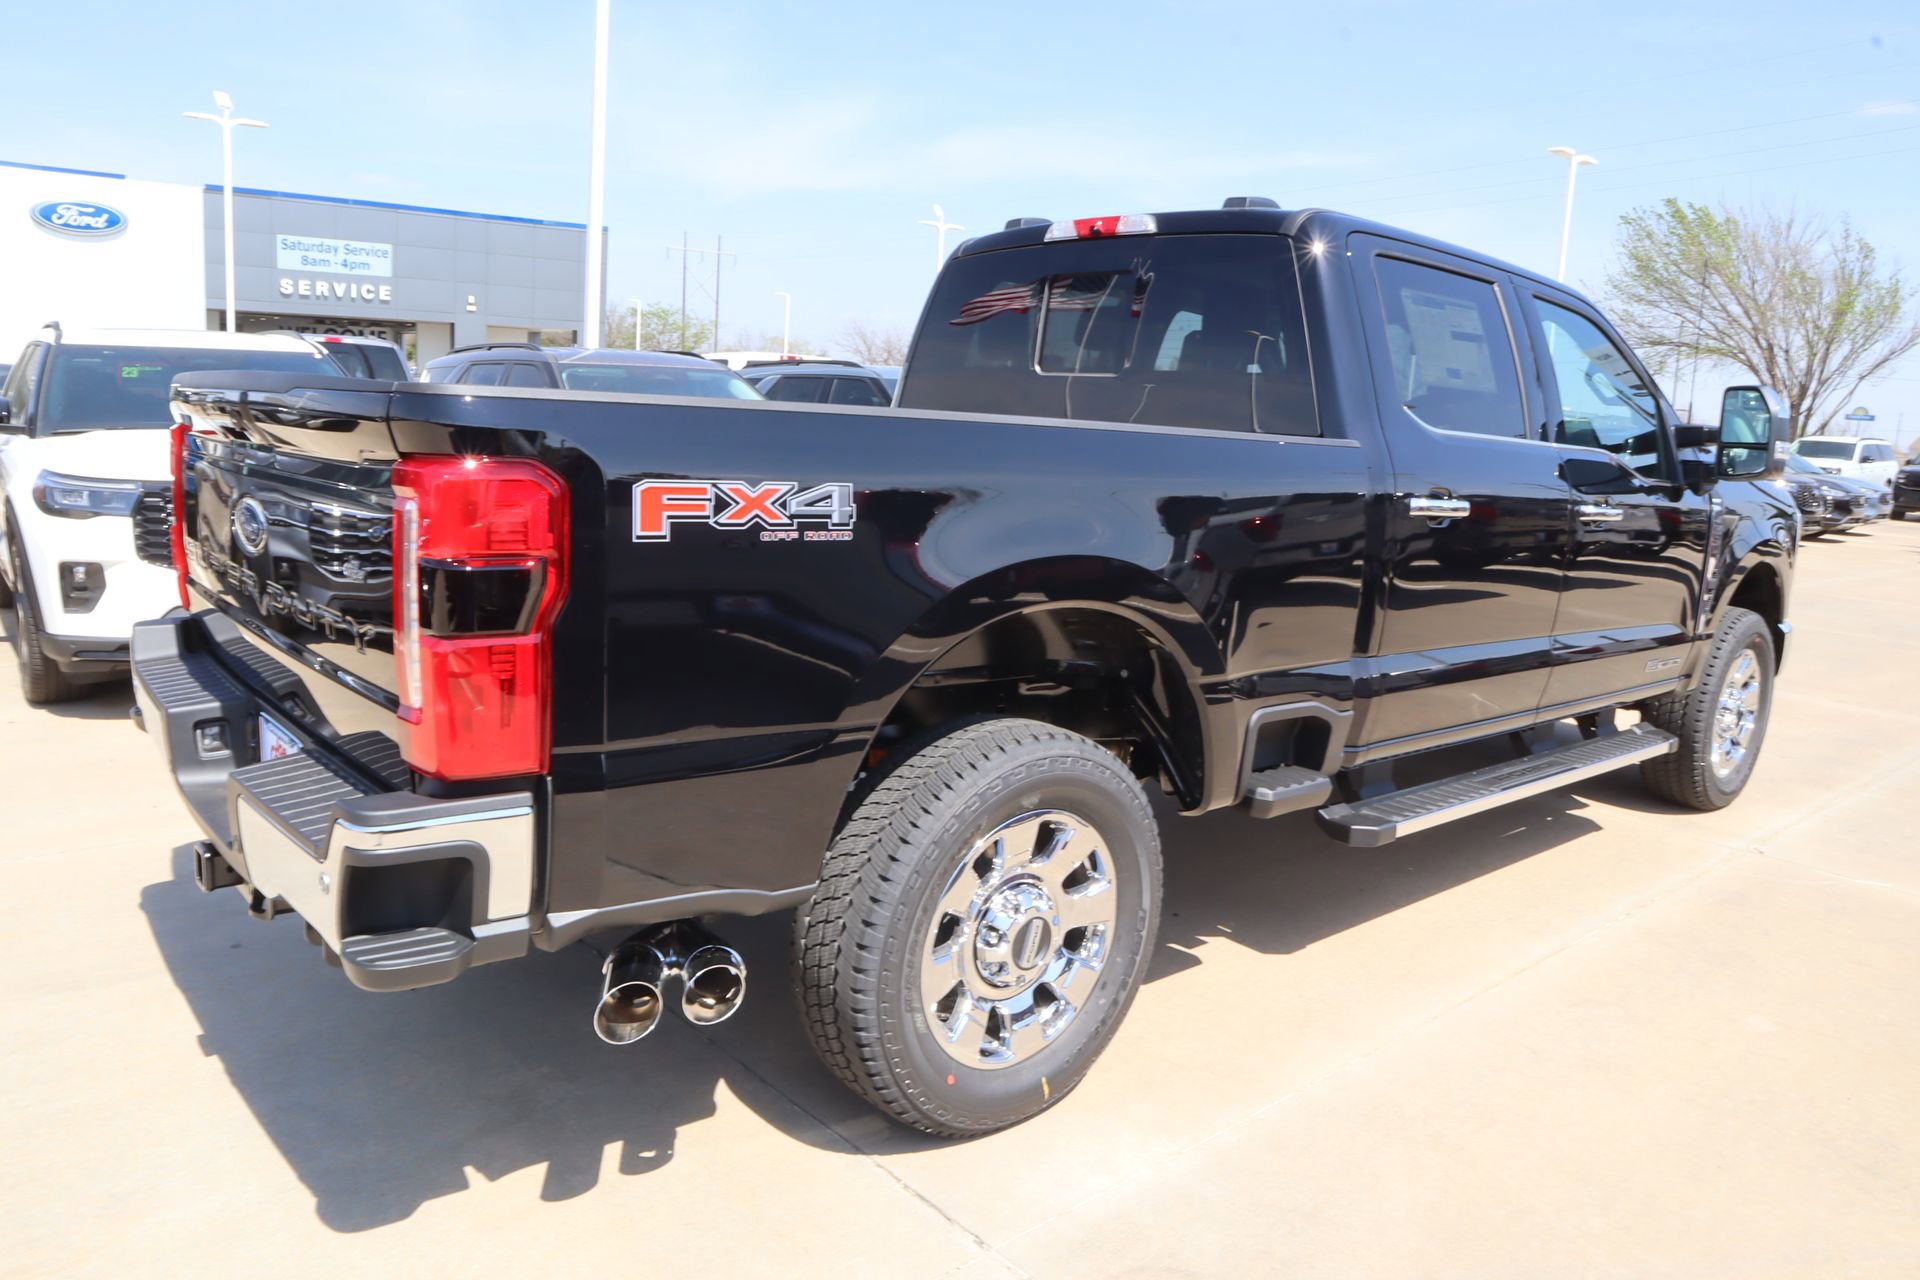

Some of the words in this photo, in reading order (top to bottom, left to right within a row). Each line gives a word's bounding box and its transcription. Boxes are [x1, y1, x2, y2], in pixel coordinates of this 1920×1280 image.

[51, 204, 109, 228] Ford
[280, 238, 339, 256] Saturday
[343, 243, 389, 259] Service
[280, 278, 392, 301] SERVICE
[632, 479, 857, 542] FX4
[760, 531, 799, 541] OFF
[804, 531, 854, 541] ROAD
[262, 580, 376, 655] DUTY
